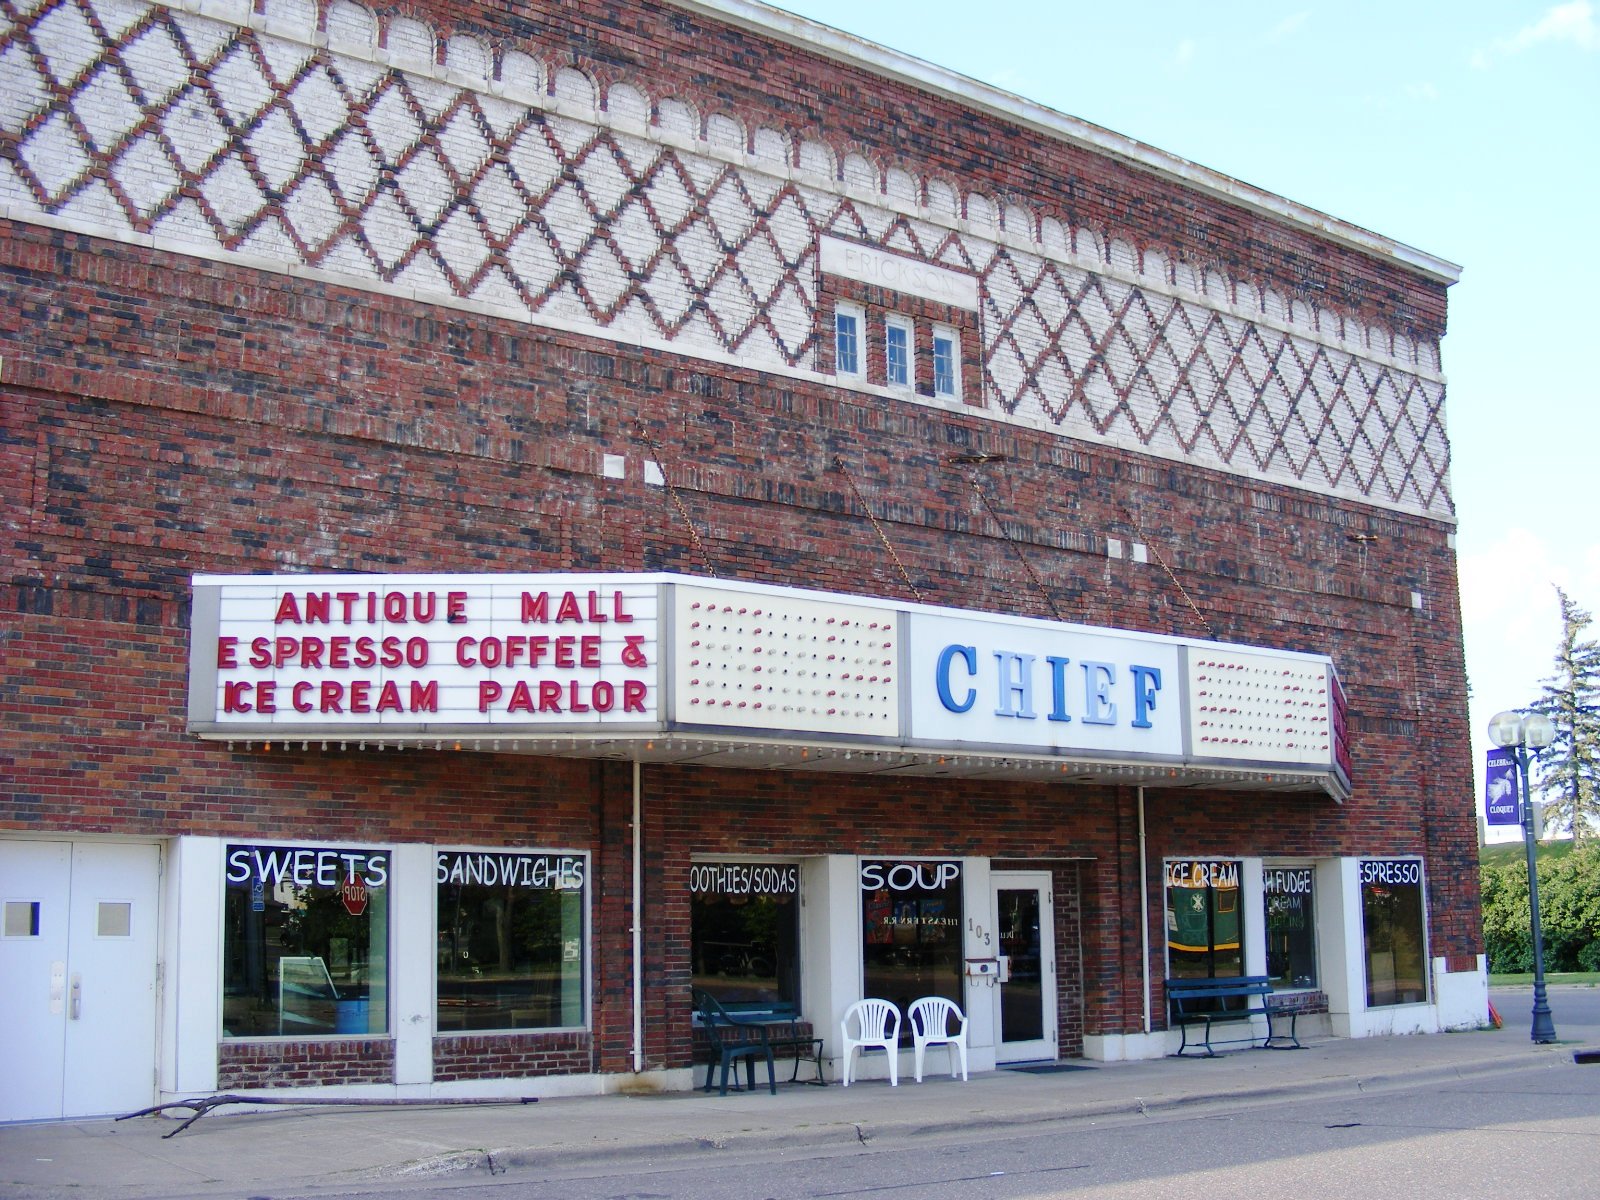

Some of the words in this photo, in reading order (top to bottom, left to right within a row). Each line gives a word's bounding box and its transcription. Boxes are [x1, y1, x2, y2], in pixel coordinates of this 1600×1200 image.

[845, 248, 955, 297] ERICKSON
[275, 591, 468, 625] ANTIQUE
[520, 590, 634, 624] MALL
[217, 636, 430, 670] ESPRESSO
[455, 635, 602, 669] COFFEE
[620, 635, 648, 668] &
[224, 681, 277, 714] ICE
[292, 680, 439, 714] CREAM
[478, 680, 648, 714] PARLOR
[936, 643, 1162, 729] CHIEF
[1490, 805, 1514, 814] CLOQUET
[227, 850, 388, 887] SWEETS
[438, 854, 584, 889] SANDWICHES
[862, 863, 960, 891] SOUP
[1165, 863, 1189, 888] ICE
[1193, 863, 1239, 887] CREAM
[1276, 871, 1311, 894] FUDGE
[968, 917, 991, 946] 103
